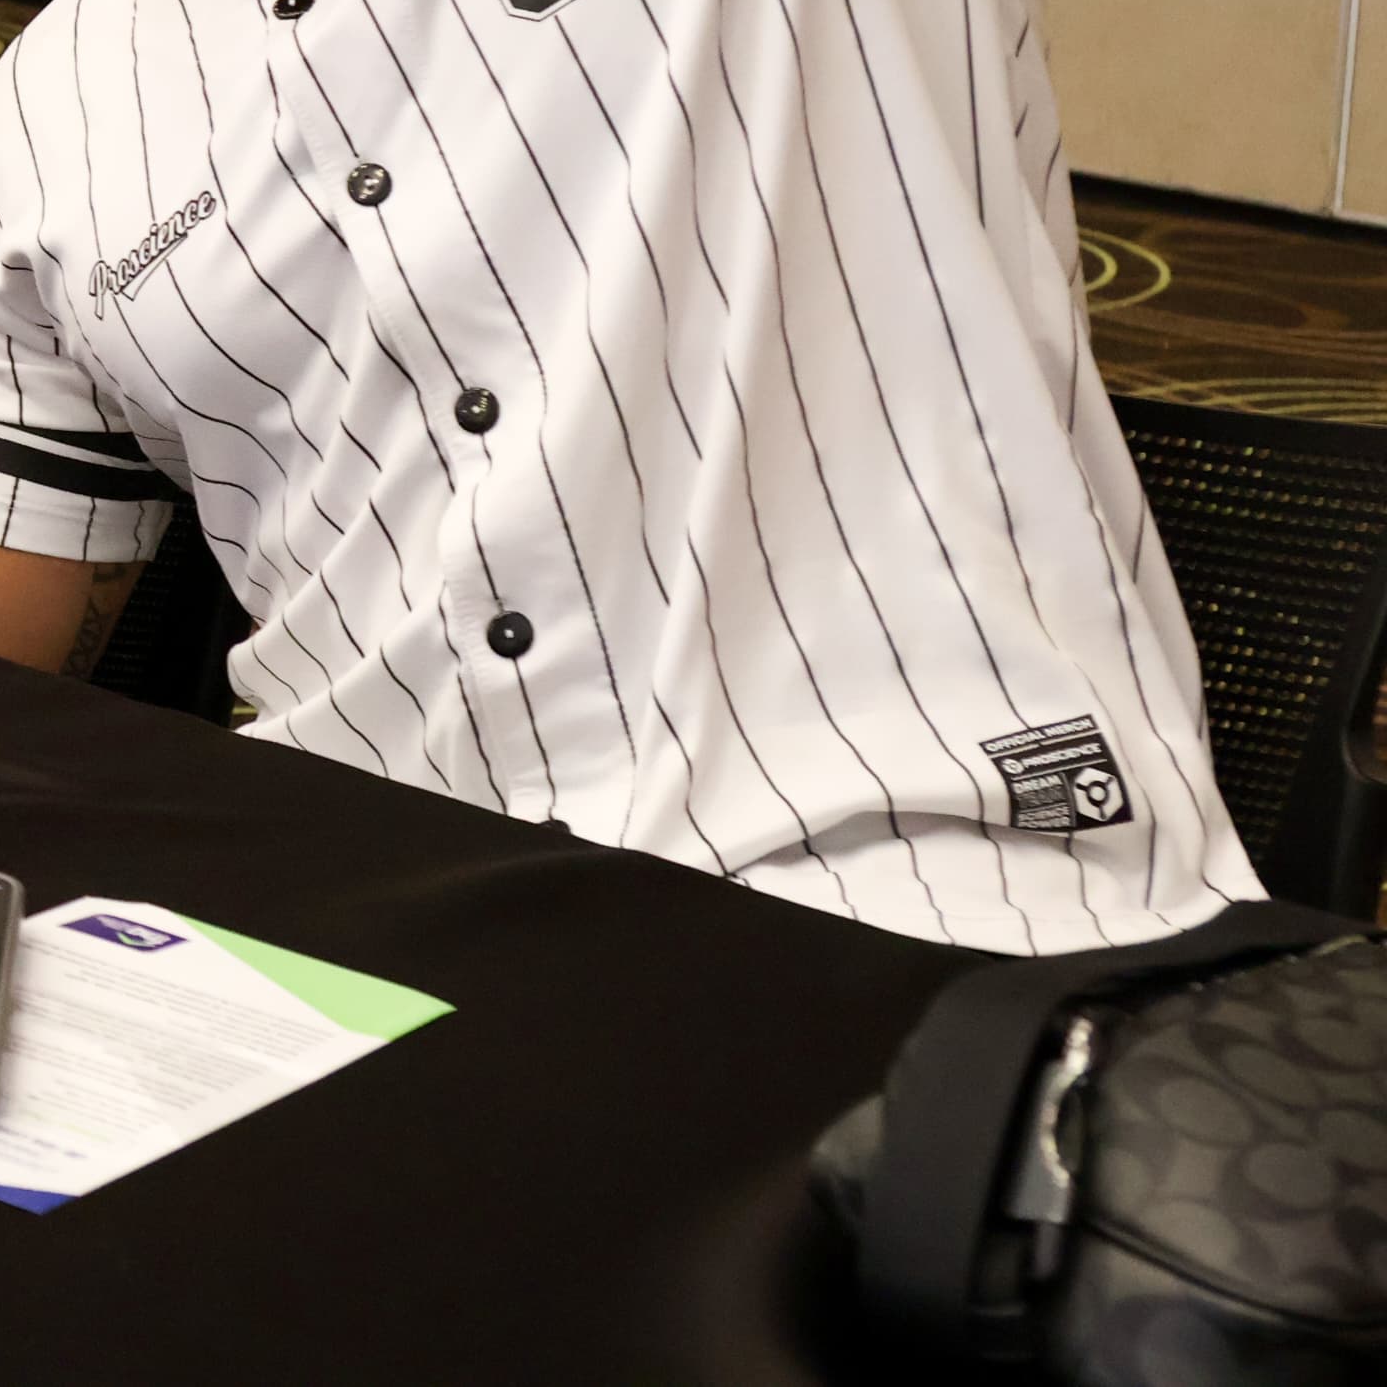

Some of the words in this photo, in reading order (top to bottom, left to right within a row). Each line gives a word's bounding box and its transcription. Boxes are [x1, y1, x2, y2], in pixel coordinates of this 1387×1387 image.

[89, 191, 217, 320] Proscience
[985, 729, 1046, 752] OFFICIAL
[1043, 718, 1094, 738] MERCH
[1013, 774, 1063, 794] DREAM
